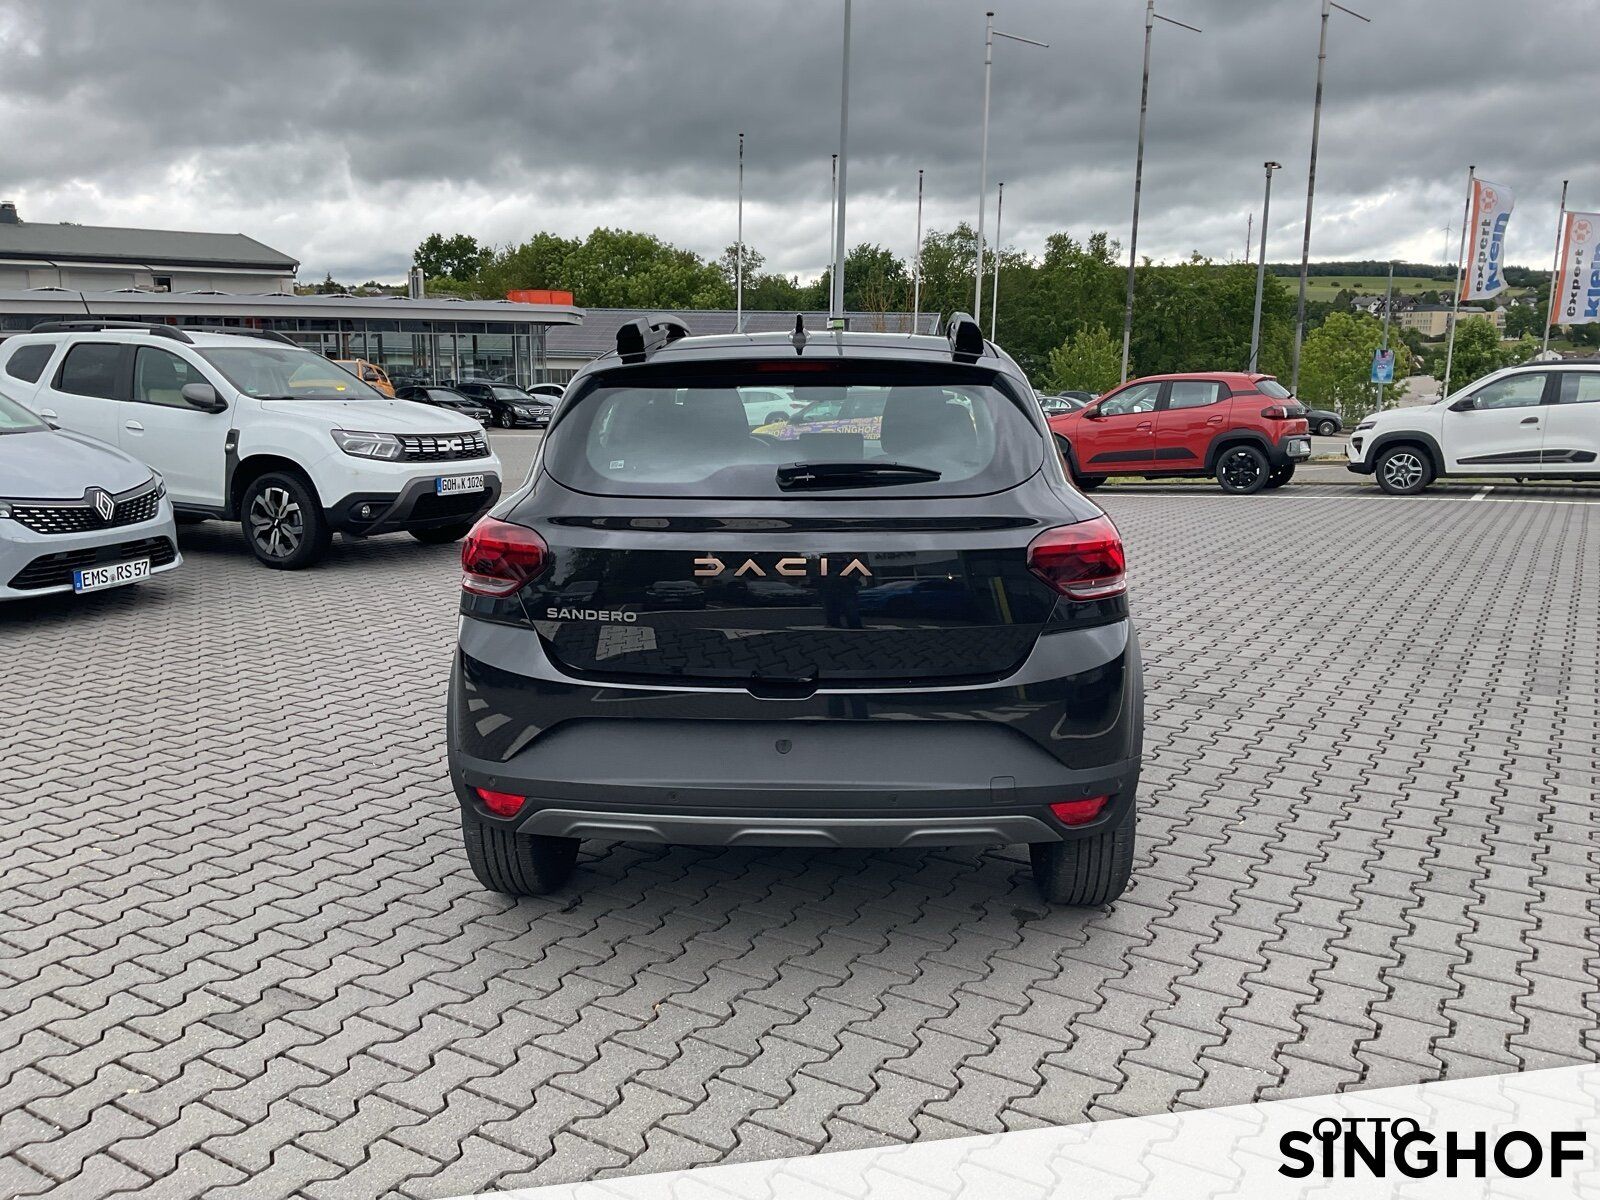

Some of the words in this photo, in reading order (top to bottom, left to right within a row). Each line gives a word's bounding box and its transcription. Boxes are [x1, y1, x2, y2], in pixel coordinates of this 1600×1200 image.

[1476, 219, 1491, 292] expert
[1567, 249, 1583, 317] expert
[82, 569, 109, 588] EMS
[116, 564, 132, 580] RS
[134, 561, 148, 577] 57
[694, 558, 873, 577] DACIA
[546, 607, 637, 622] SANDERO
